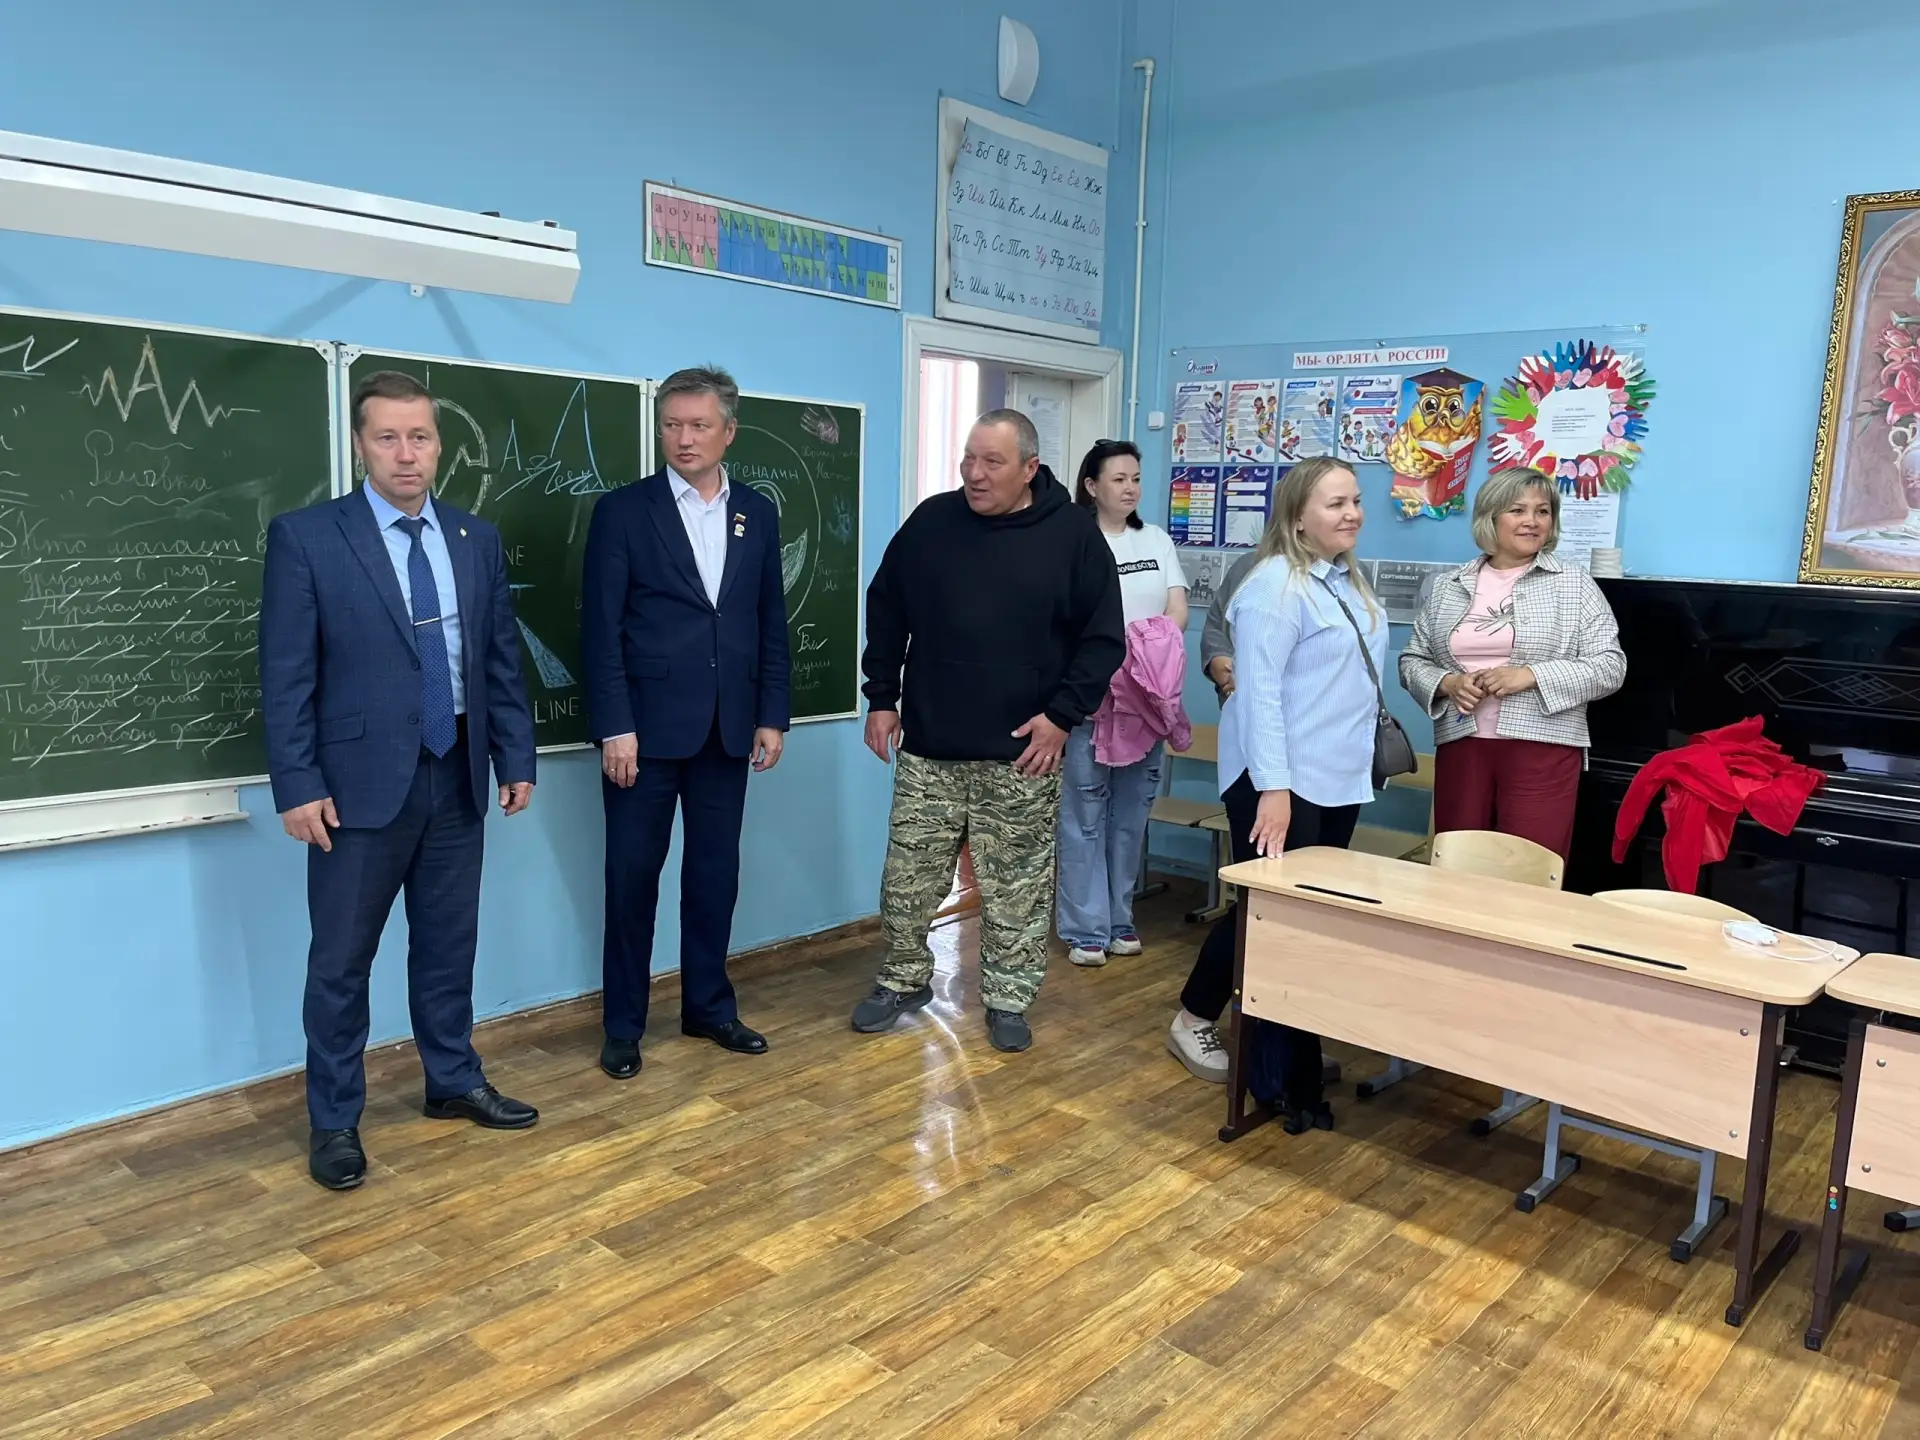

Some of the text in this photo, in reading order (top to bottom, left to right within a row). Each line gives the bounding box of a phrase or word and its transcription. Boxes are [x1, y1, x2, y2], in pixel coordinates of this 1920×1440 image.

[976, 141, 995, 160] Бб
[996, 148, 1011, 166] Вв
[1014, 153, 1028, 172] Гг
[1031, 160, 1048, 184] Дд
[1051, 165, 1063, 183] Ее
[1084, 176, 1102, 195] Жж
[952, 180, 1100, 236] Зз Ии Йй Кк Лл Мм Нн Оо
[952, 224, 1099, 278] Пп Рр Сс Тт Уу Фф Хх Цц
[953, 271, 965, 290] Чч
[970, 276, 989, 296] Шш
[994, 281, 1015, 303] Щщ
[1082, 300, 1097, 317] Яя
[1326, 352, 1380, 365] ОРЛЯТА
[1388, 347, 1446, 362] РОССИИ
